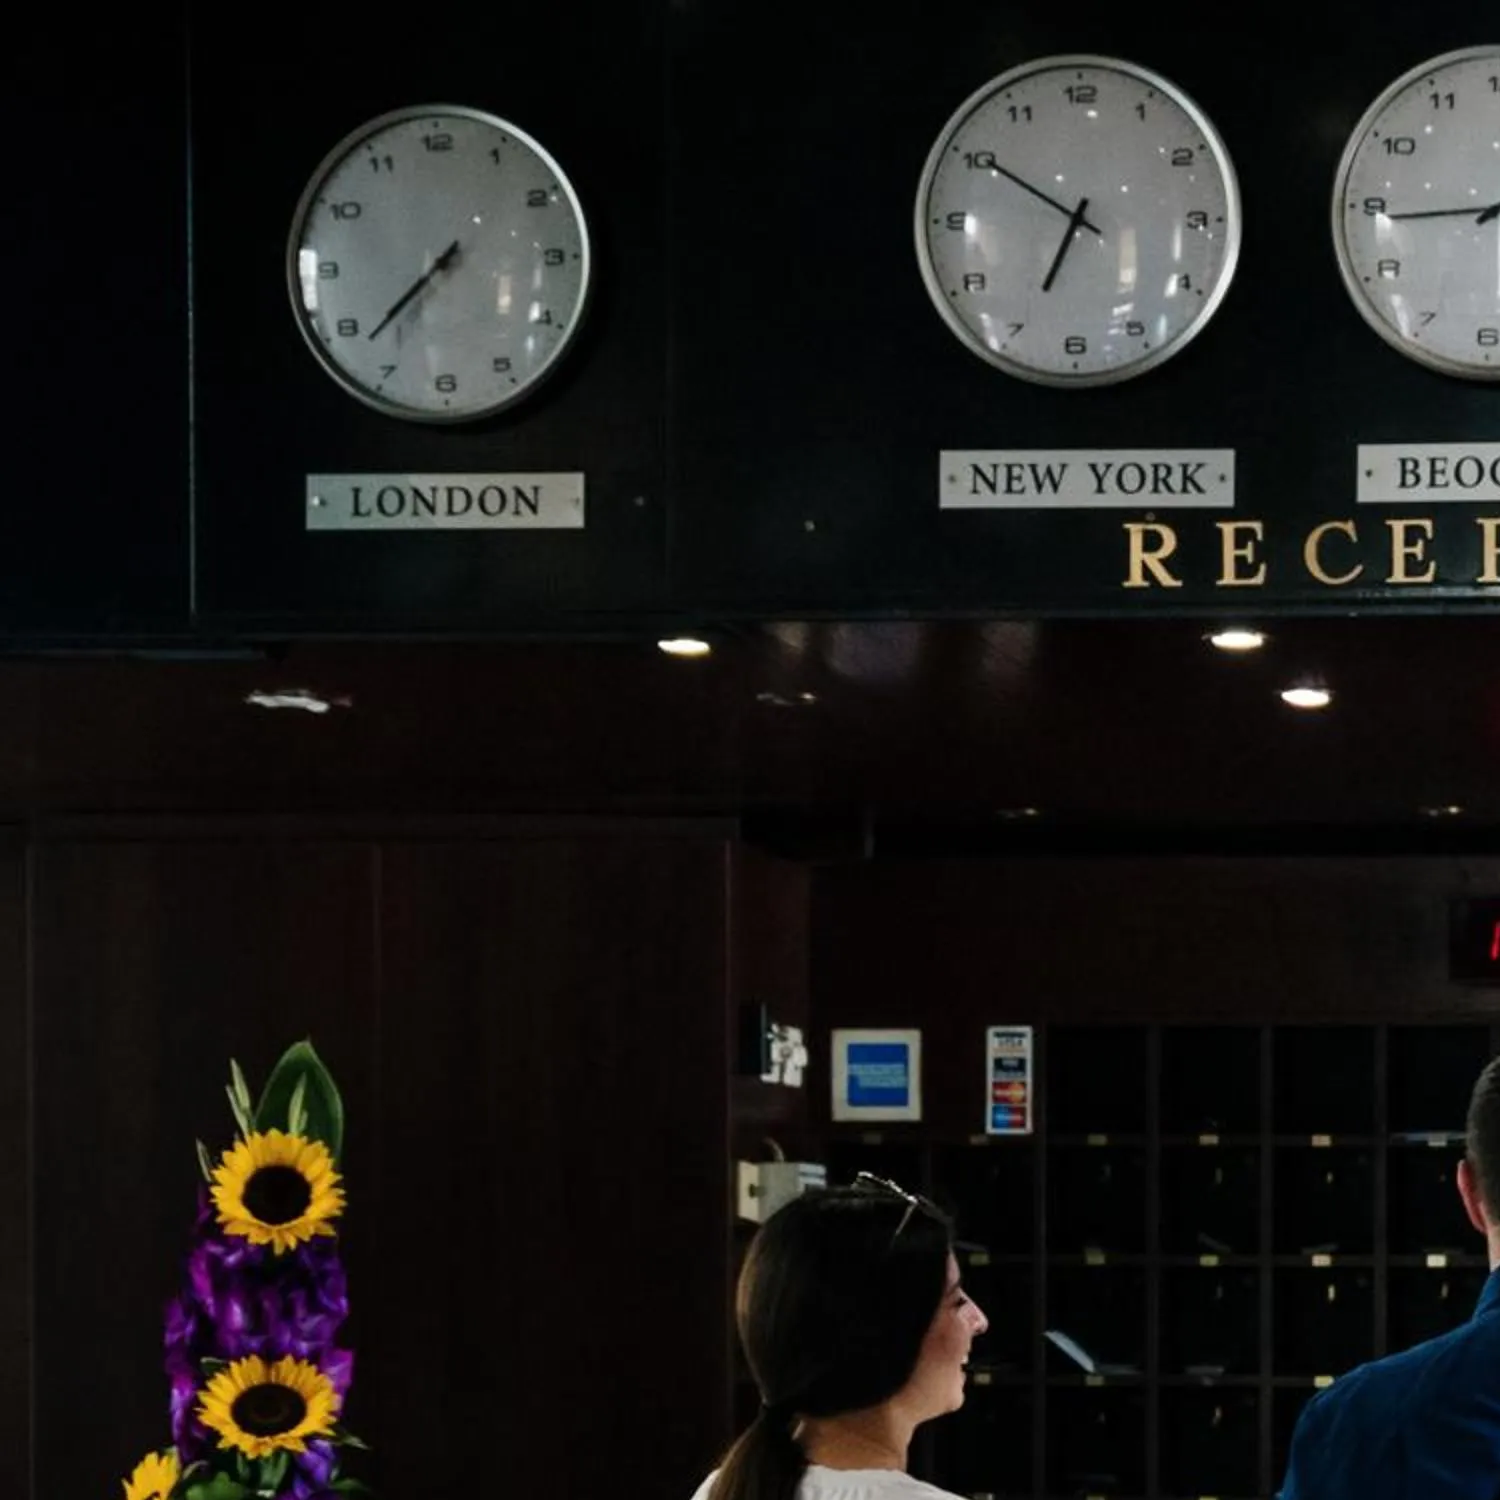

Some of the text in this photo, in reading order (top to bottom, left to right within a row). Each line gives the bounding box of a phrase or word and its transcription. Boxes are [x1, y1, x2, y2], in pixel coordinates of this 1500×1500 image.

[1064, 86, 1098, 104] 12
[1430, 93, 1455, 109] 11
[1008, 106, 1033, 122] 11
[1136, 104, 1145, 120] 1
[421, 133, 455, 152] 12
[1383, 138, 1415, 155] 10
[370, 156, 393, 173] 11
[489, 148, 500, 165] 1
[964, 152, 996, 169] 10
[1171, 149, 1194, 166] 2
[527, 189, 548, 207] 2
[331, 202, 361, 220] 10
[1187, 212, 1208, 229] 3
[544, 248, 564, 266] 3
[318, 262, 339, 279] 9
[537, 309, 552, 326] 4
[1420, 312, 1436, 325] 7
[338, 319, 359, 337] 8
[1007, 324, 1024, 337] 7
[1126, 321, 1144, 337] 5
[1065, 337, 1087, 354] 6
[1478, 328, 1499, 346] 6
[380, 364, 396, 378] 7
[493, 357, 511, 372] 5
[435, 375, 457, 393] 6
[969, 462, 1207, 495] NEW YORK
[351, 485, 543, 518] LONDON
